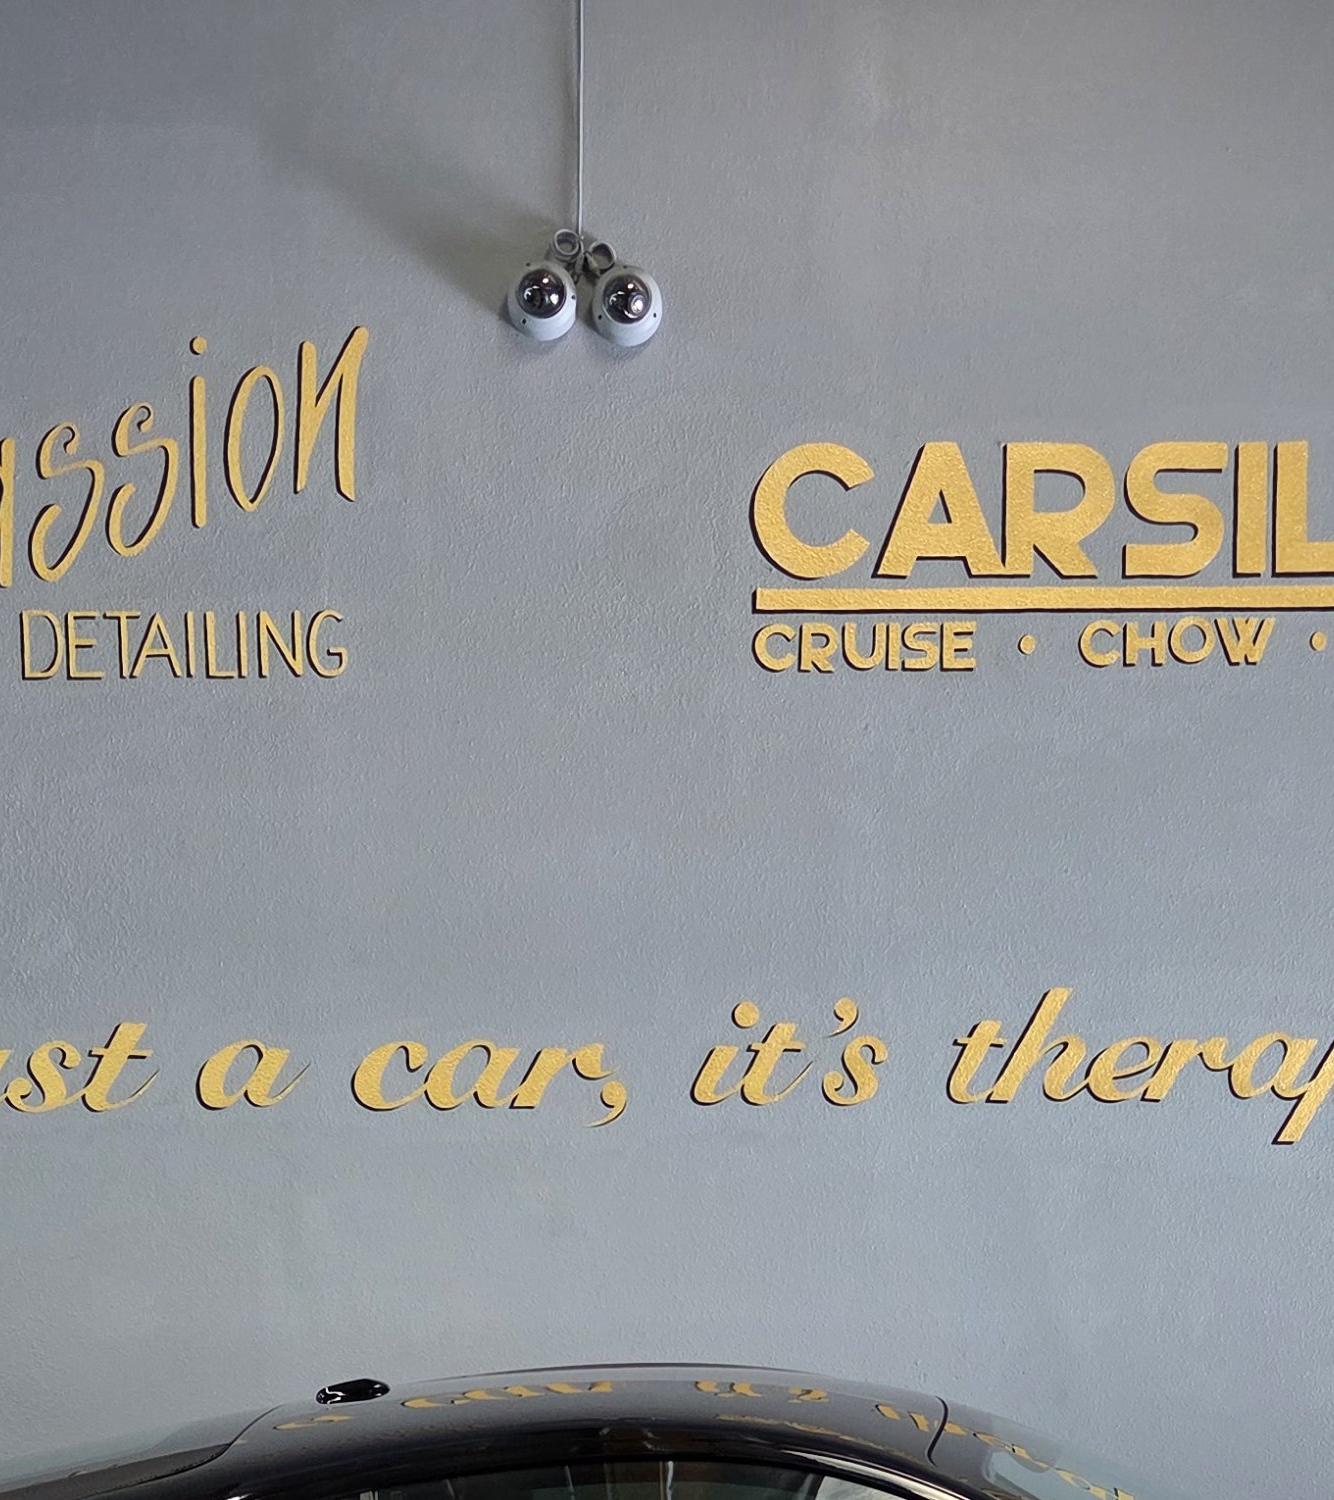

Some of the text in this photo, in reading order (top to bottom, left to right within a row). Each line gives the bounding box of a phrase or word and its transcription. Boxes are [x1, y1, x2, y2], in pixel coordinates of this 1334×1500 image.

[20, 610, 351, 681] DETAILING
[753, 620, 978, 675] CRUISE
[1078, 616, 1276, 669] CHOW
[197, 1038, 311, 1113] a
[351, 1038, 629, 1129] car,
[689, 998, 890, 1108] it's
